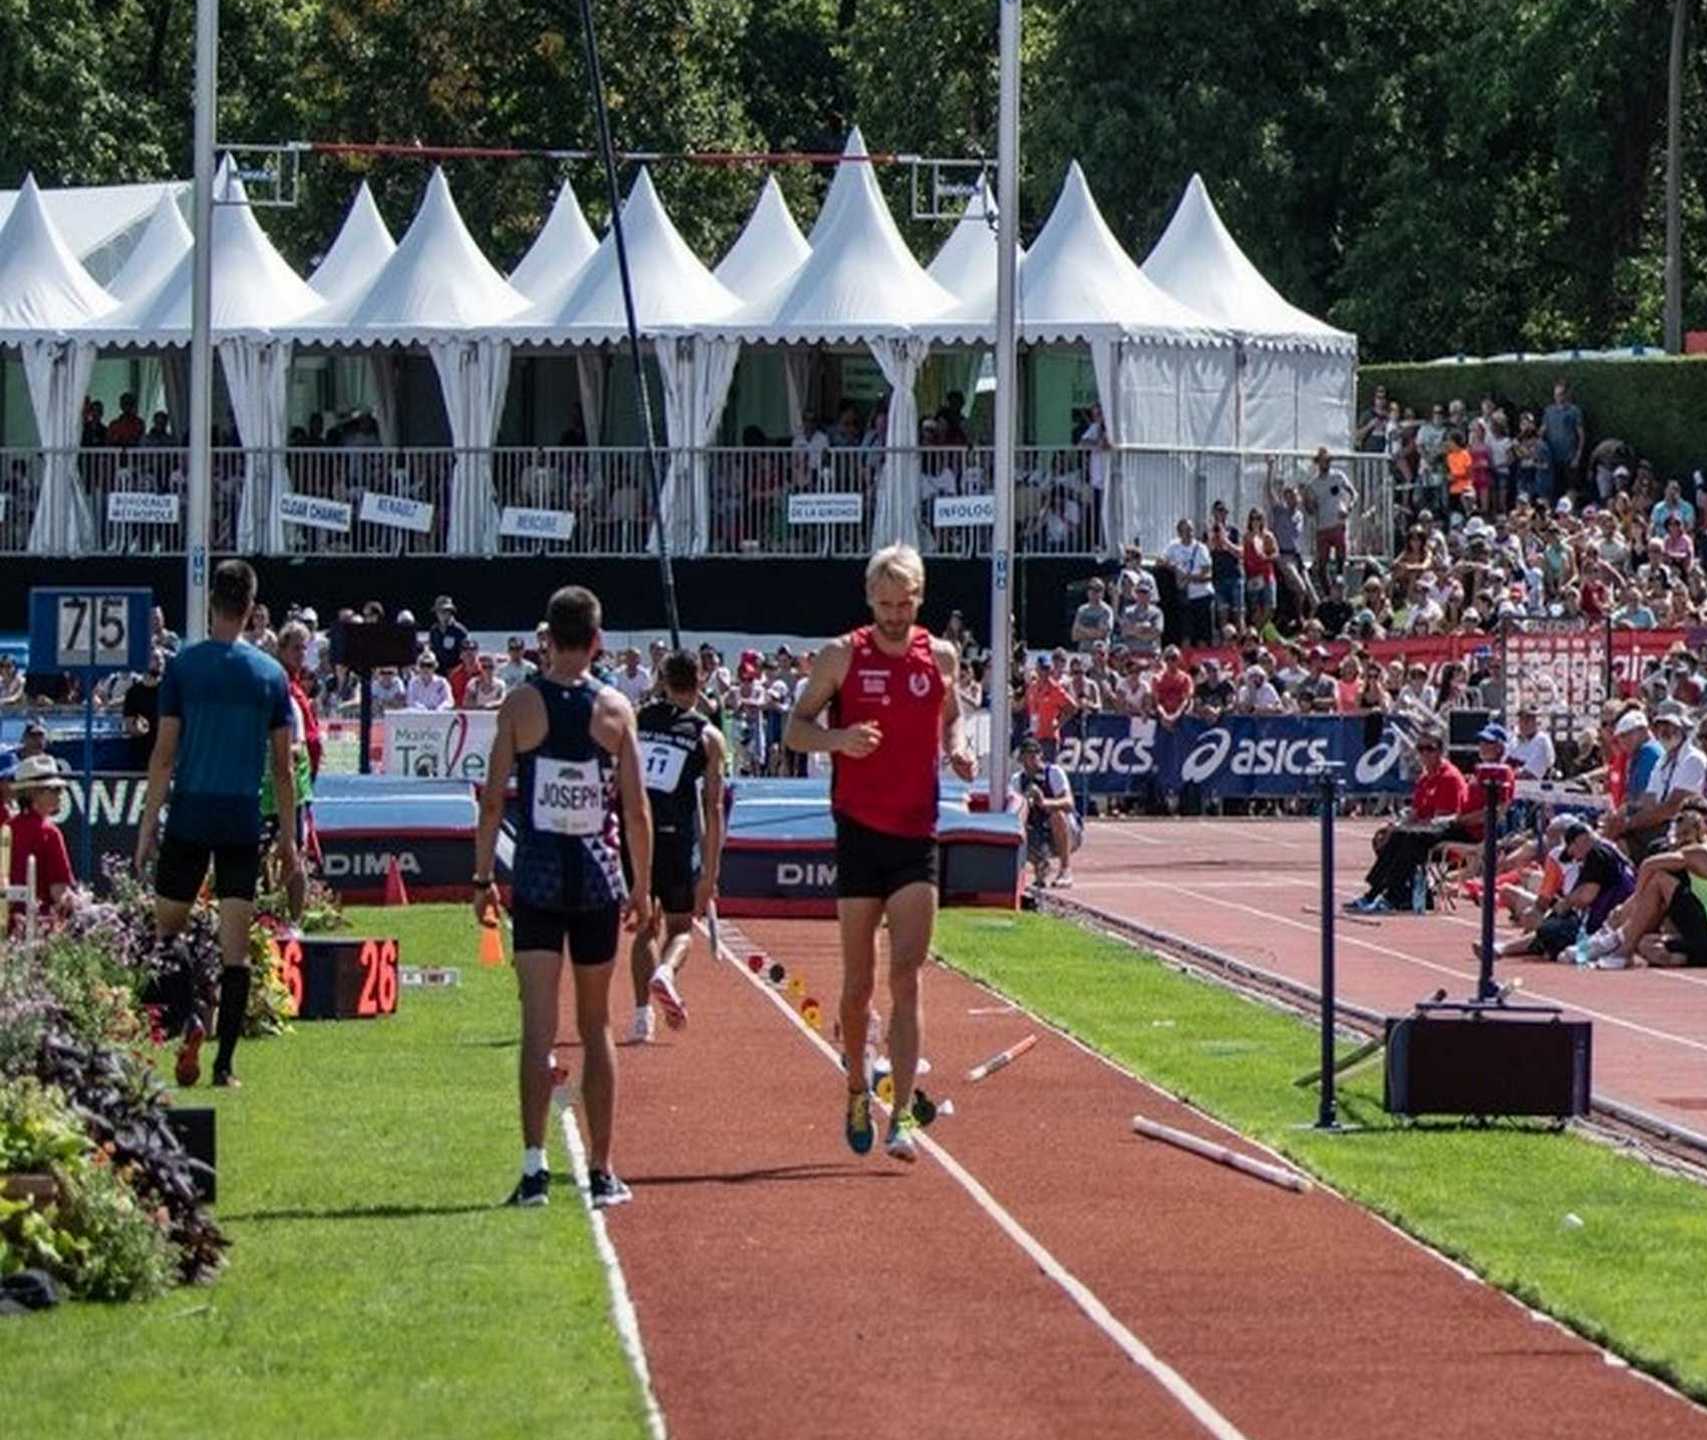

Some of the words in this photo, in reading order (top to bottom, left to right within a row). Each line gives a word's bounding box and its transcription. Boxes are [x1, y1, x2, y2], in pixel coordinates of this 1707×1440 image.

[62, 596, 126, 651] 75
[1231, 739, 1328, 775] asics
[538, 782, 600, 810] JOSEPH
[324, 853, 421, 877] DIMA
[359, 939, 397, 1015] 26
